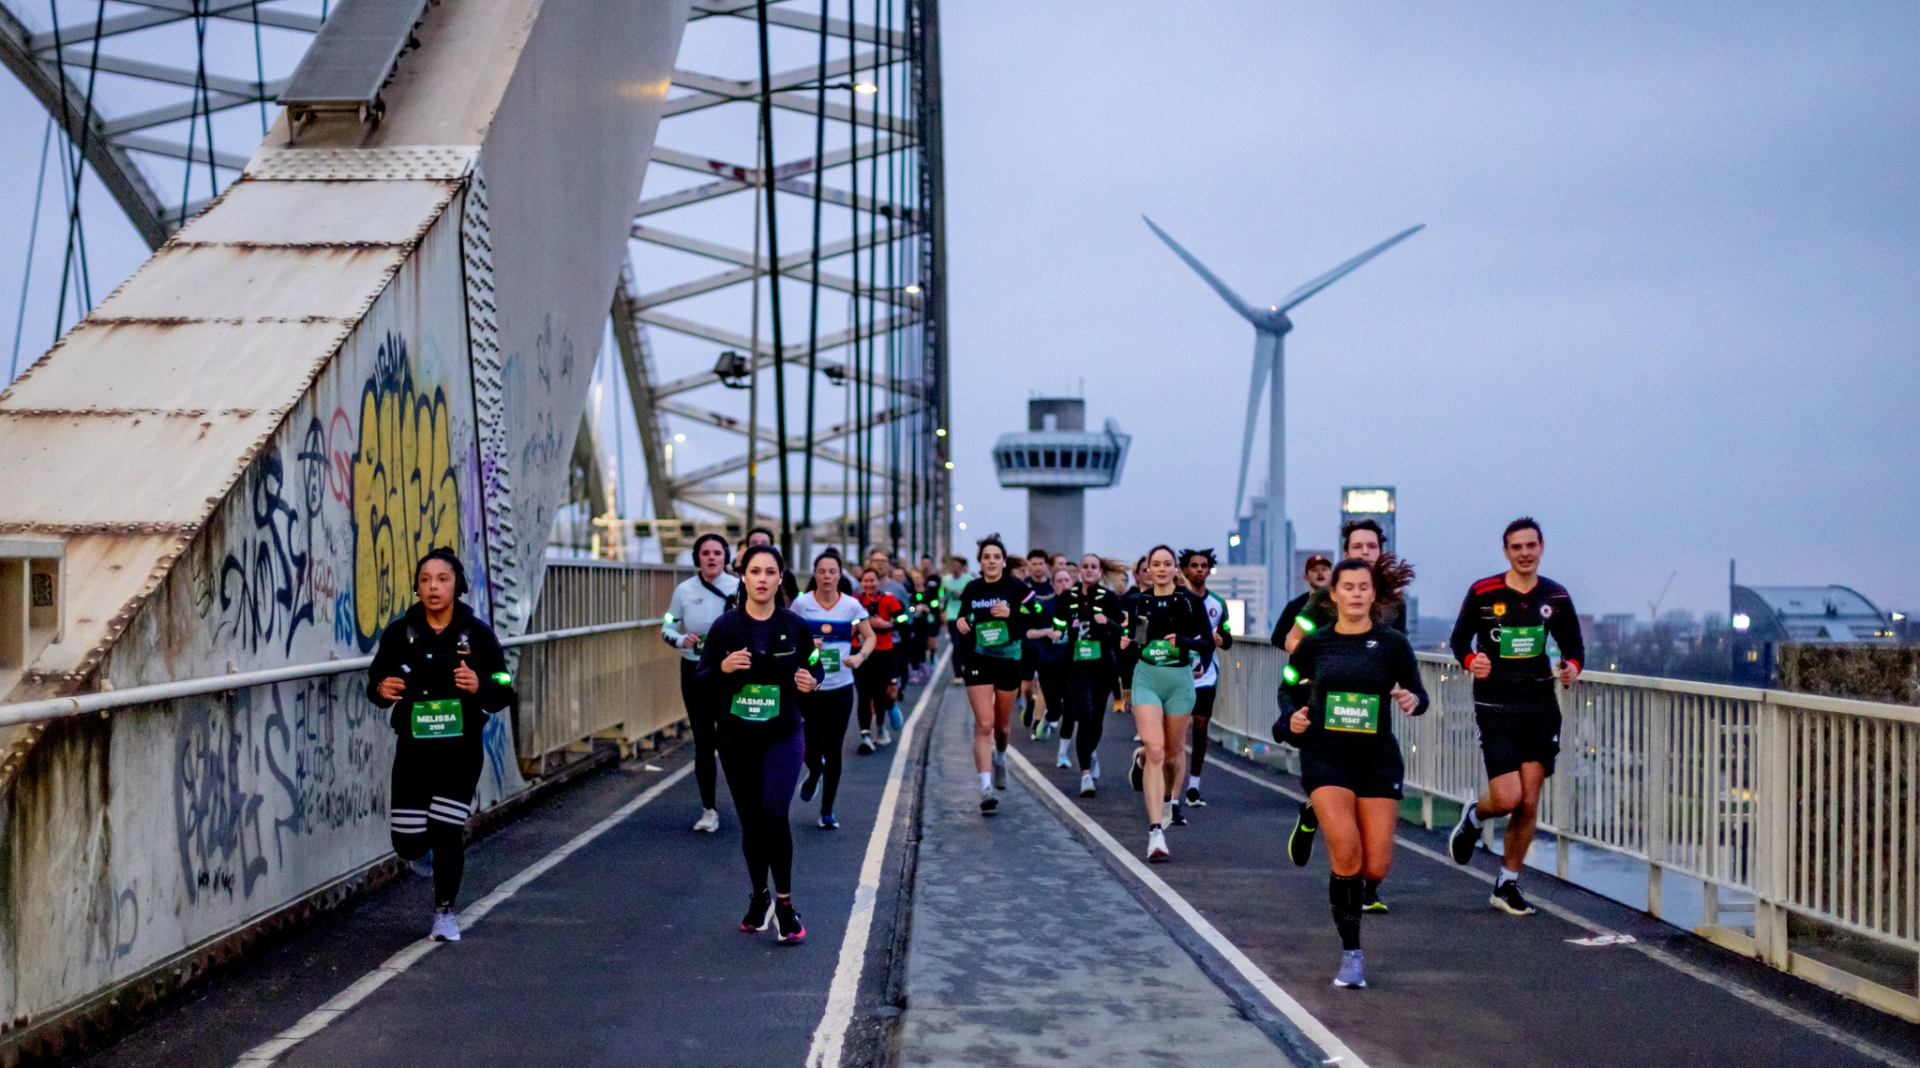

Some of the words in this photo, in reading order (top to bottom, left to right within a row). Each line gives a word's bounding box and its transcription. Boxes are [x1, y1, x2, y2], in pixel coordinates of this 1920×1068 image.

[736, 697, 775, 706] JASMIJN
[1334, 706, 1369, 717] EMMA
[416, 714, 457, 723] MELISSA
